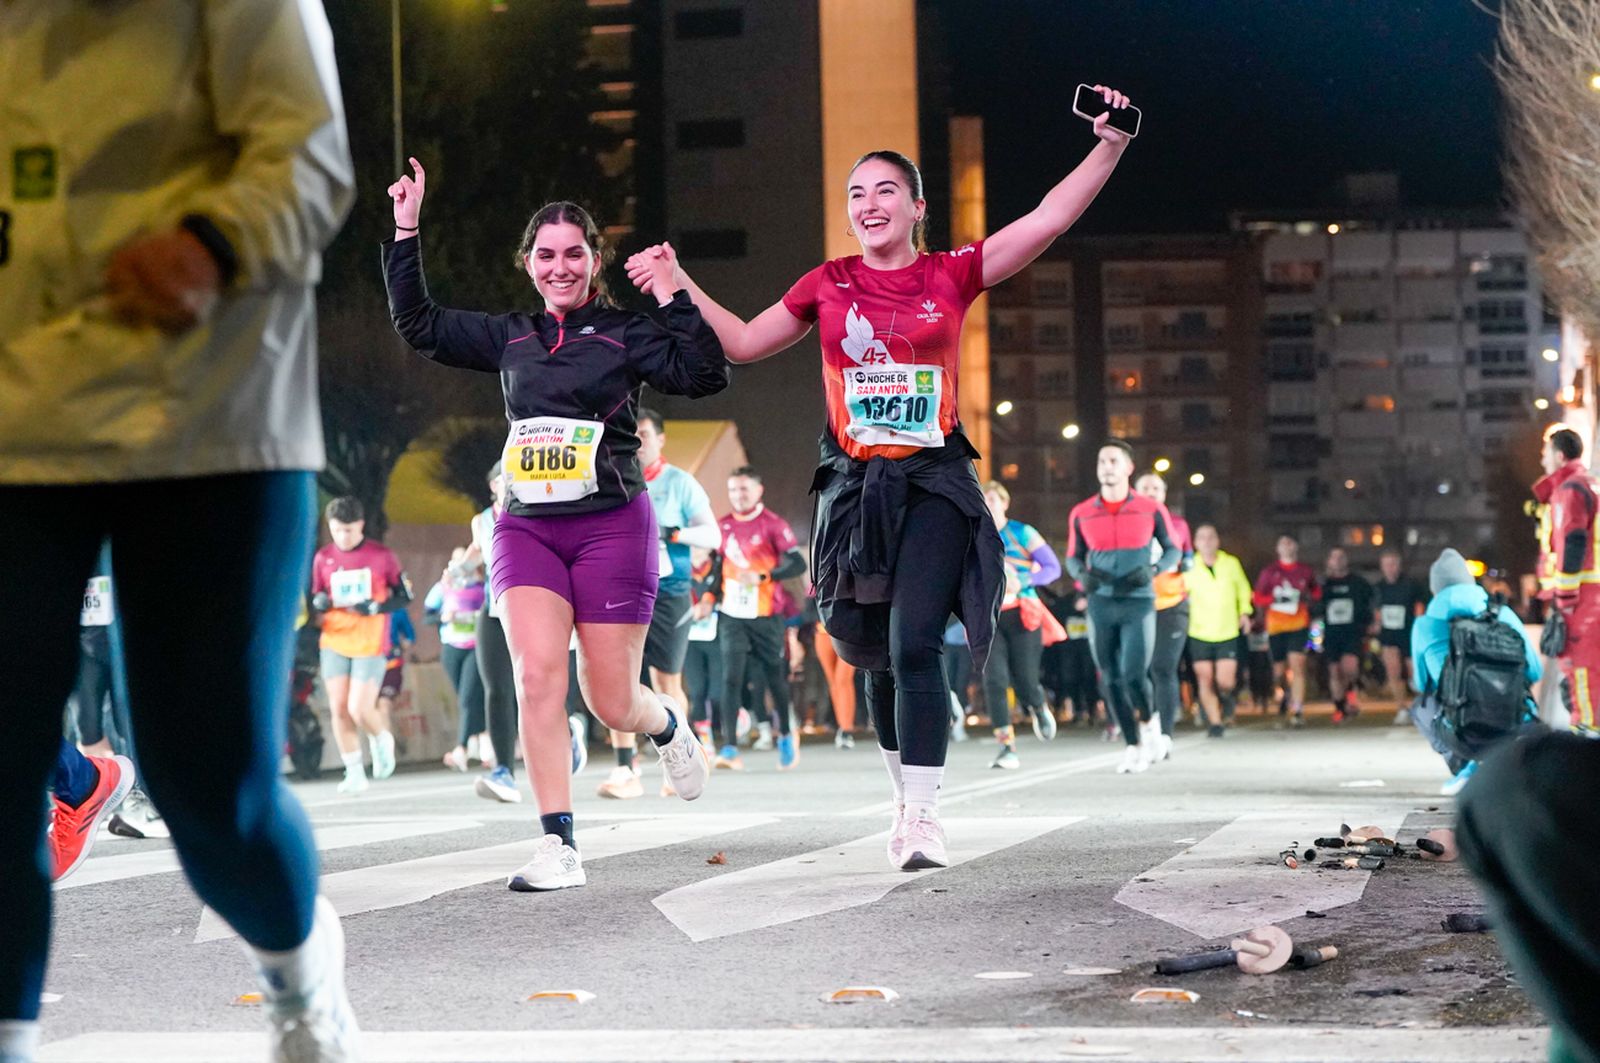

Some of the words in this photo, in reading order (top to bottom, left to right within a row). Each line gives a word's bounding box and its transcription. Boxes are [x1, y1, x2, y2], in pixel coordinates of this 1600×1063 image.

[868, 374, 896, 384] NOCHE
[897, 374, 908, 383] DE
[856, 385, 877, 395] SAN
[859, 396, 928, 423] 13610
[516, 436, 533, 445] SAN
[520, 445, 577, 472] 8186
